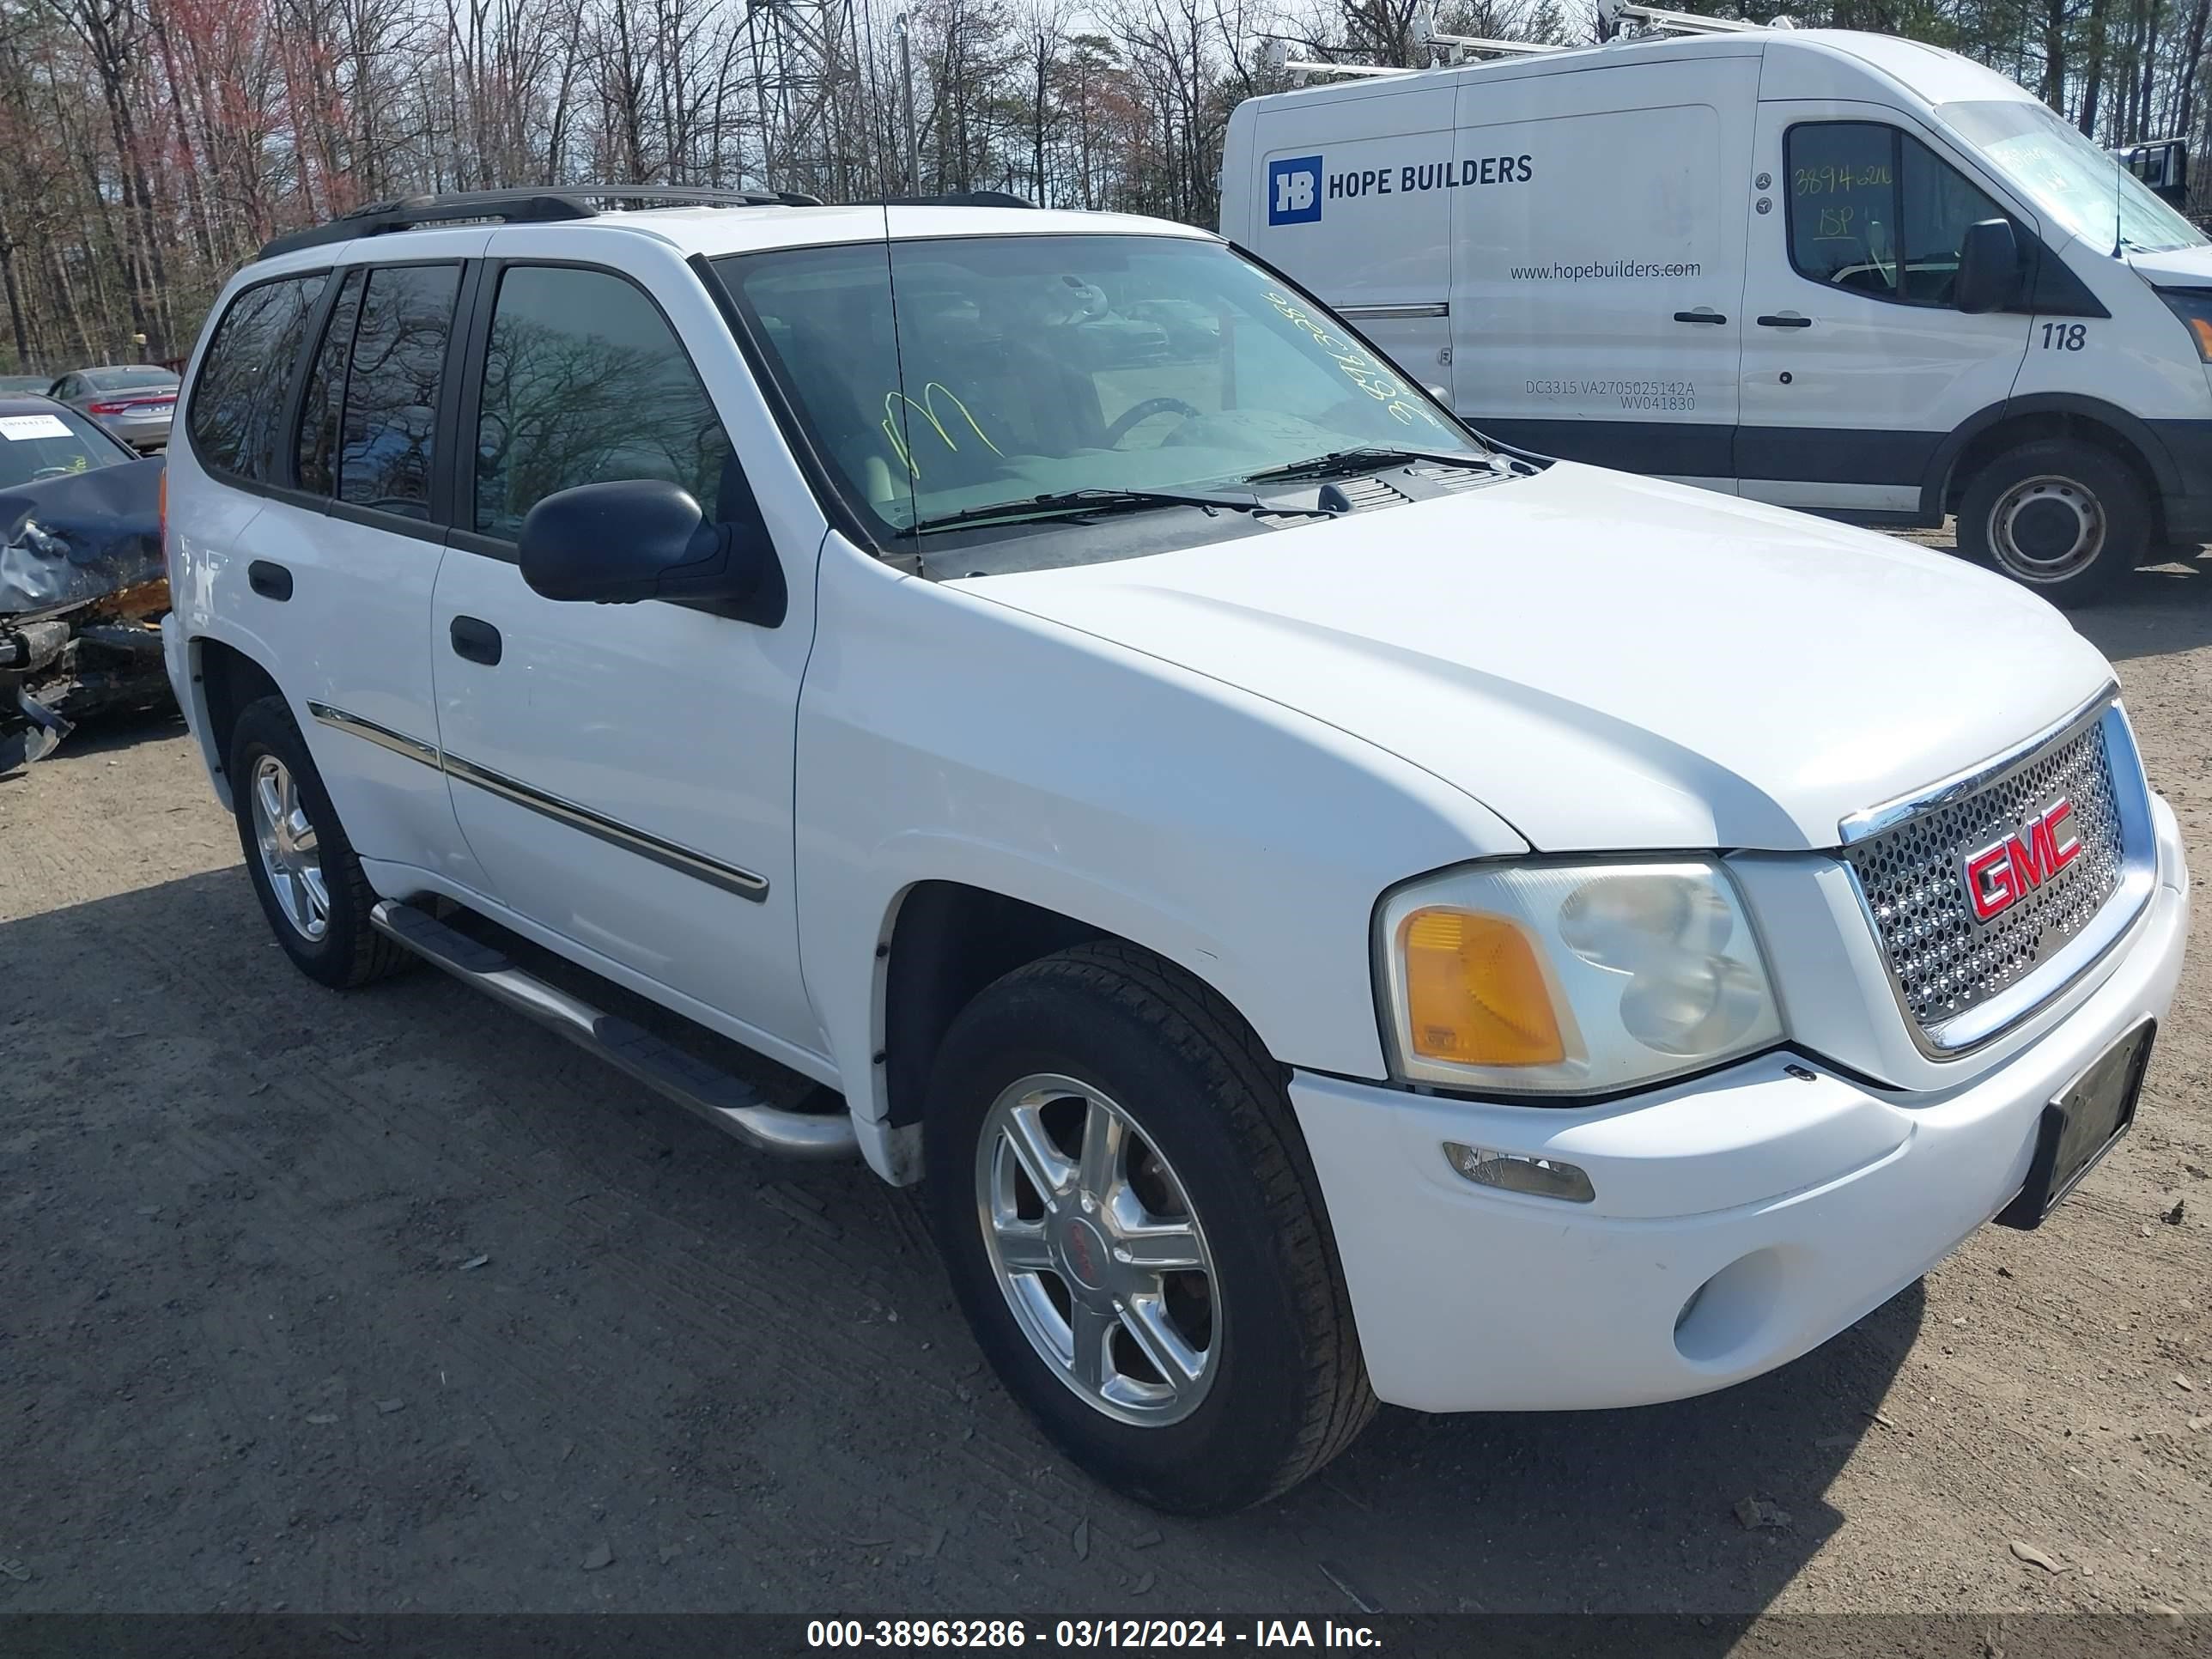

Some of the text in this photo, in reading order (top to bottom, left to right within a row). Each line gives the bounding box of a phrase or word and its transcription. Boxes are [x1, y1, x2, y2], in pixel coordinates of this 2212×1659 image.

[1329, 155, 1533, 198] HOPE BUILDERS
[1510, 259, 1701, 283] www.hopebuilders.com
[2042, 322, 2087, 352] 118
[1525, 380, 1695, 396] DC3315 VA2705025142A
[1620, 396, 1695, 410] WV041830
[1963, 796, 2082, 926] GMC
